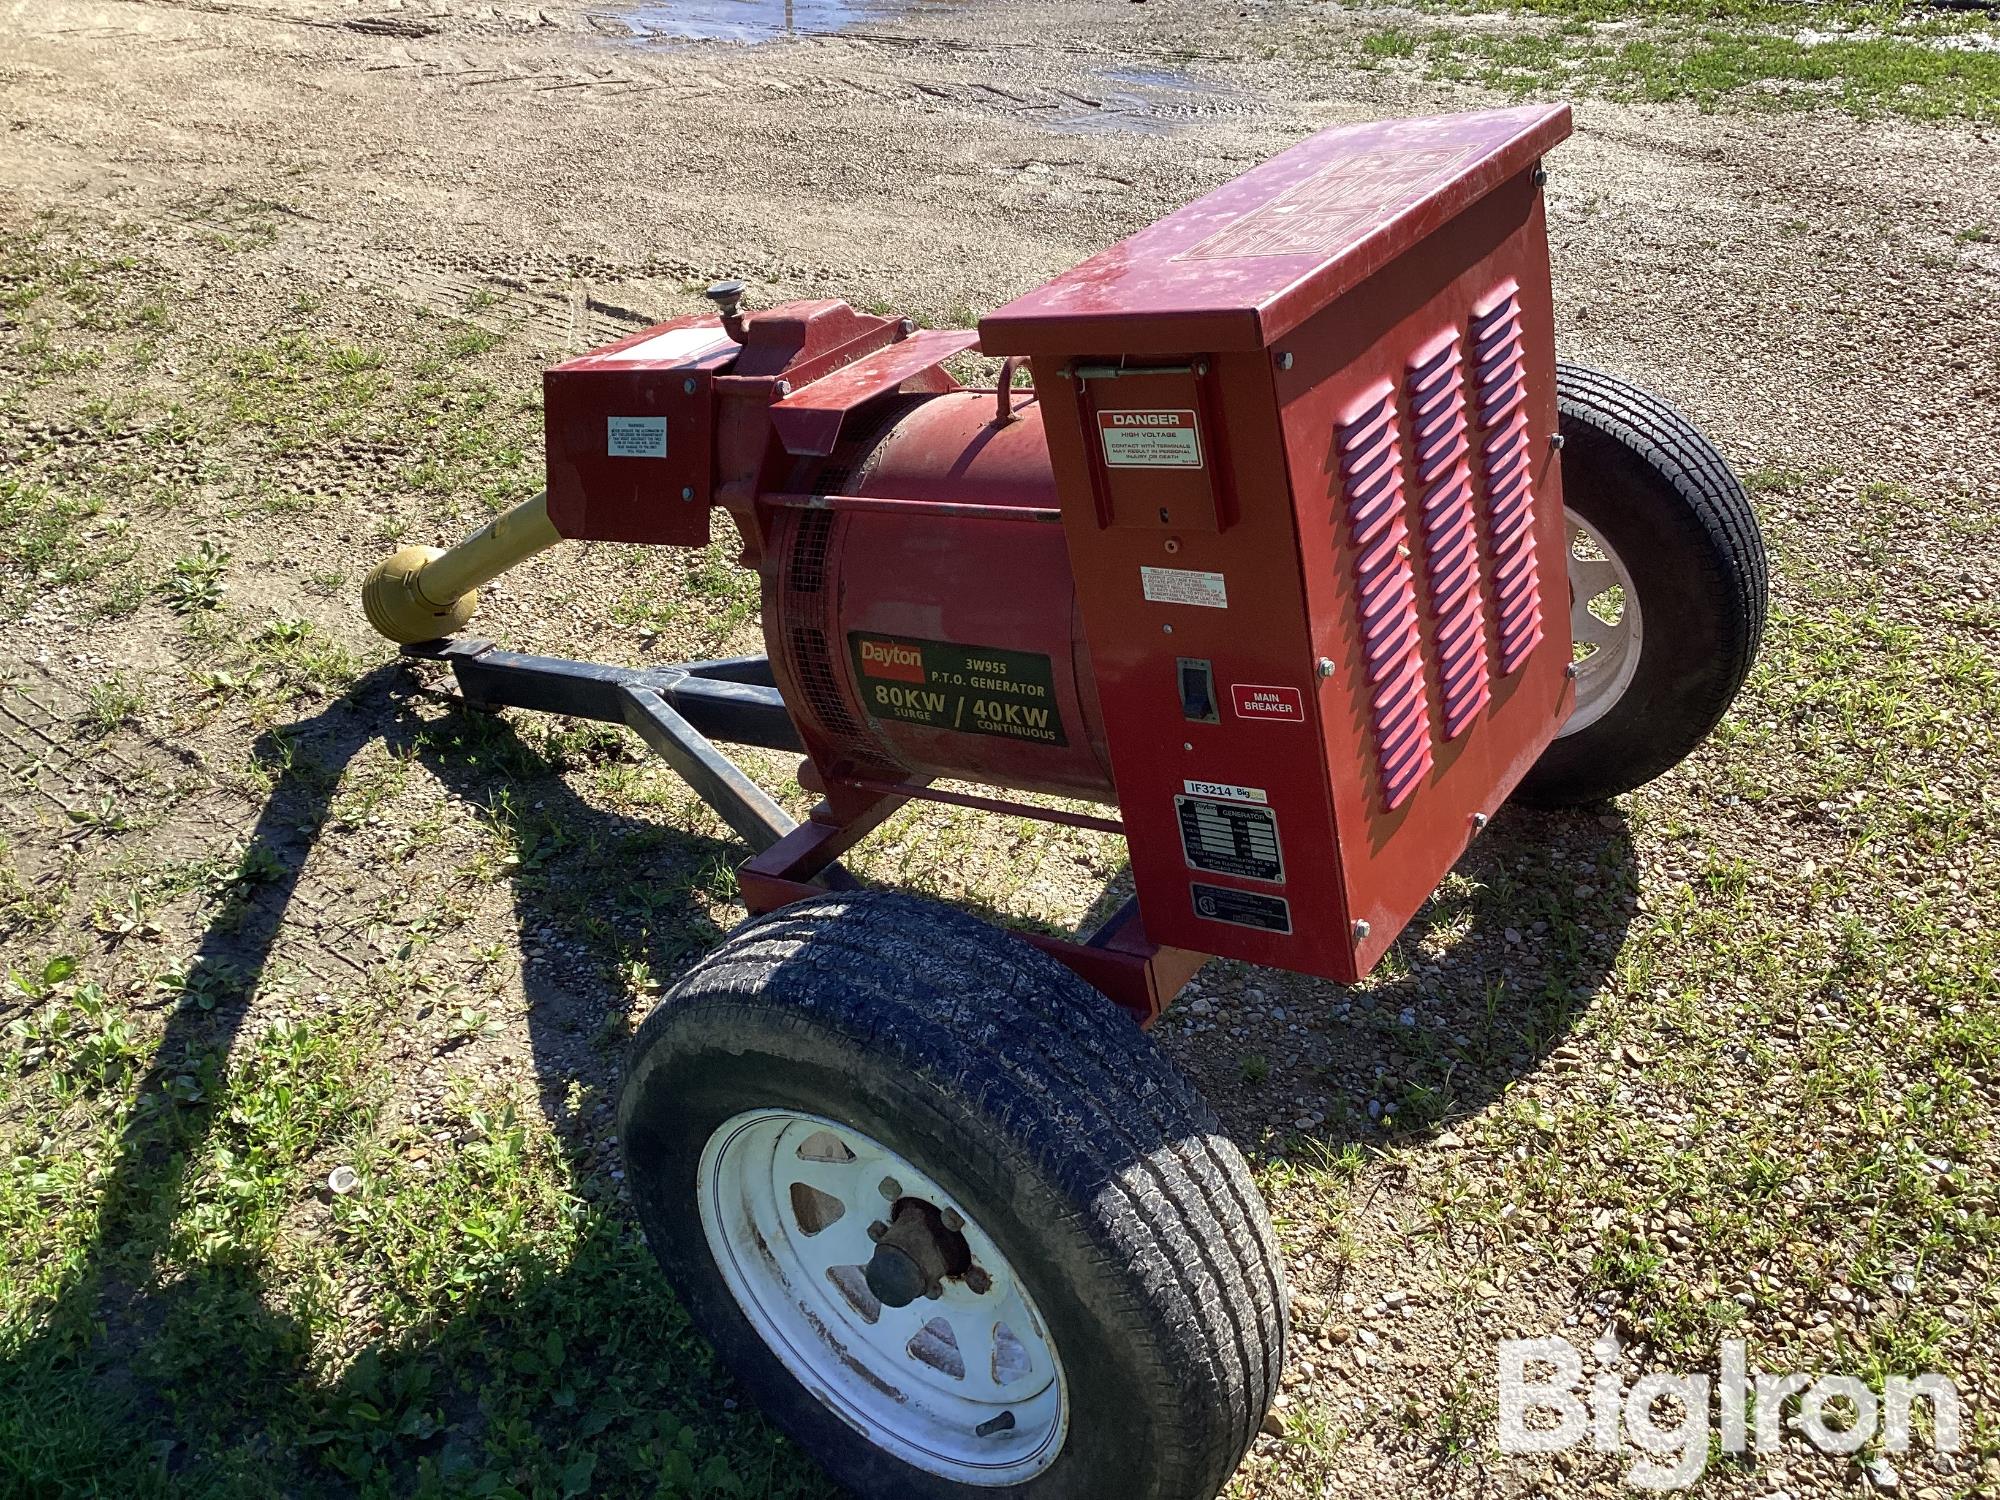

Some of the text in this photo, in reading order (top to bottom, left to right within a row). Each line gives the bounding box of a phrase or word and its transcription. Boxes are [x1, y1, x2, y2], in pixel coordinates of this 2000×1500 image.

[1113, 414, 1180, 425] DANGER
[862, 641, 921, 667] Dayton
[965, 658, 1007, 674] 3W955
[931, 671, 1045, 697] P.T.O. GENERATOR
[1253, 692, 1280, 702] MAIN
[875, 685, 946, 713] 80KW
[972, 699, 1049, 728] 40KW
[893, 706, 931, 720] SURGE
[1244, 701, 1293, 713] BREAKER
[977, 720, 1056, 740] CONTINUOUS
[1190, 782, 1233, 797] IF3214
[1222, 809, 1266, 820] GENERATOR
